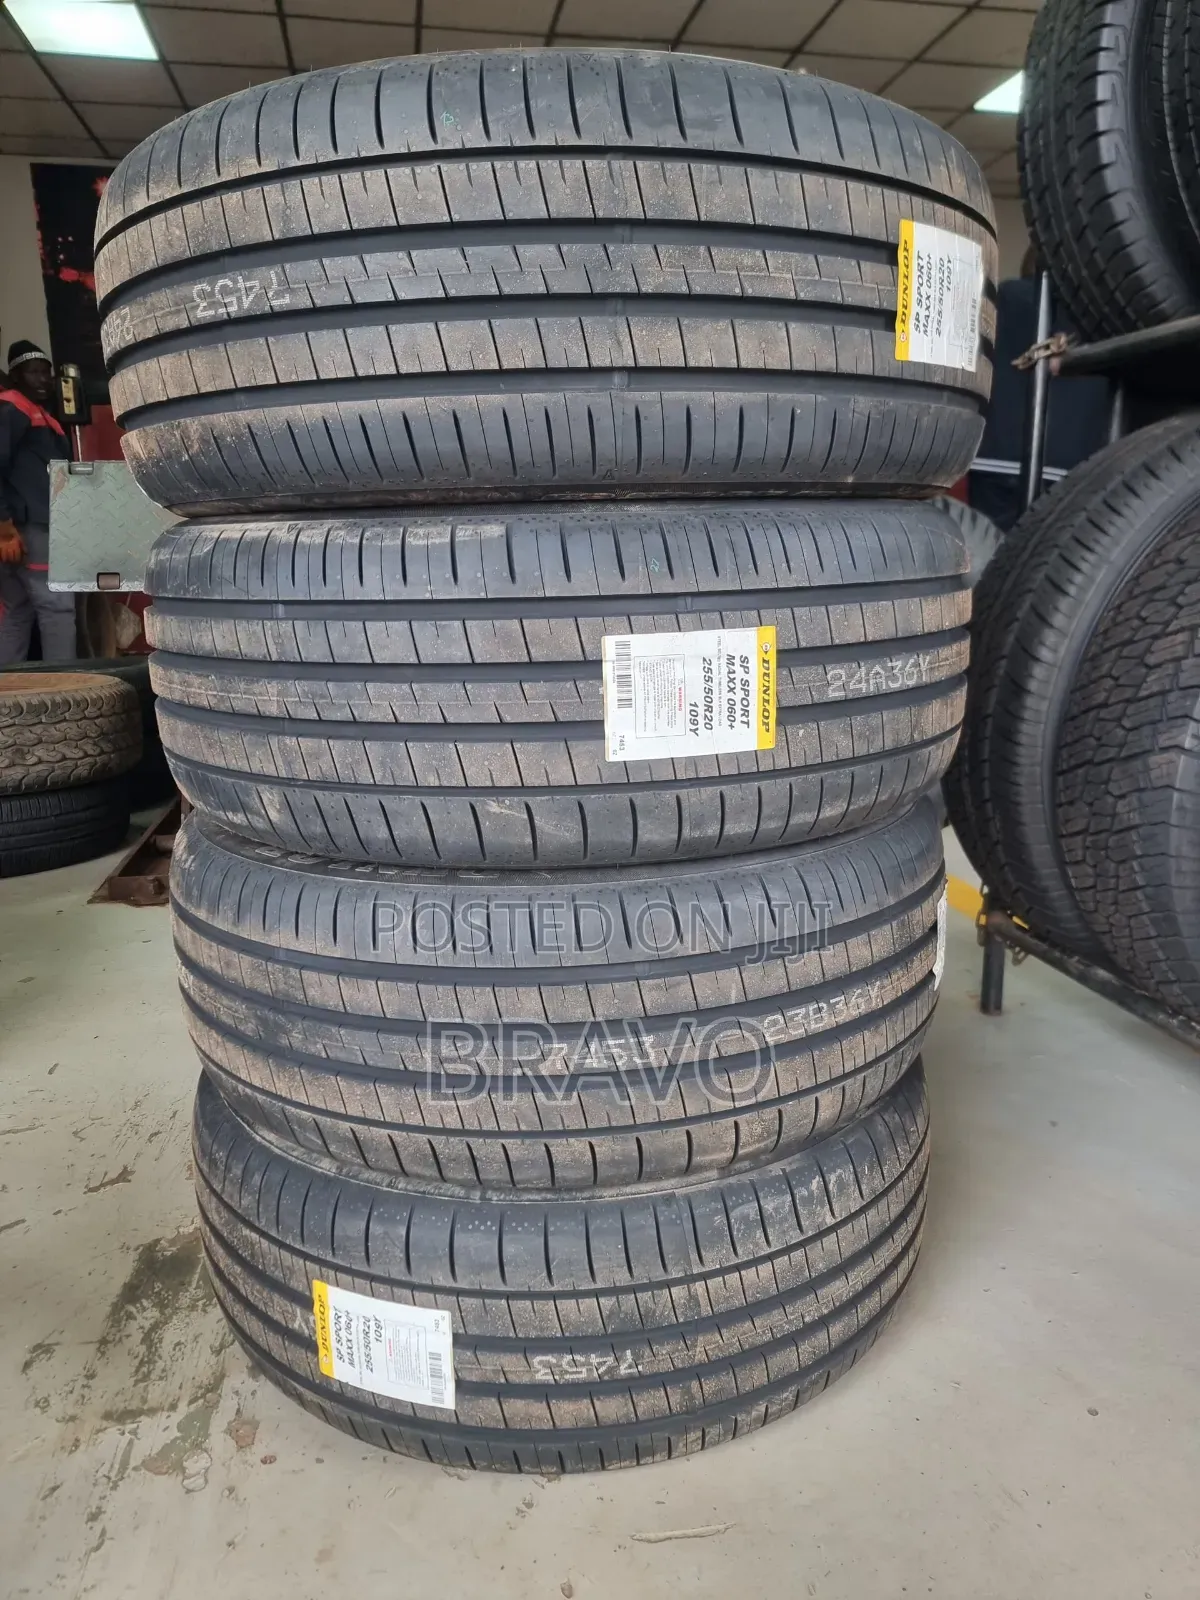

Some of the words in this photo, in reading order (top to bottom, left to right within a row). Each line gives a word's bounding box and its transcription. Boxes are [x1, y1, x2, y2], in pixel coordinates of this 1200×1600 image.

[899, 239, 910, 327] DUNLOP
[916, 250, 925, 308] SPORT
[926, 252, 934, 289] 060+
[945, 254, 953, 292] 109Y
[192, 270, 290, 318] 7453
[922, 291, 933, 338] MAXX
[935, 257, 946, 338] 255/50R20
[913, 313, 922, 334] SP
[726, 653, 737, 695] MAXX
[739, 654, 750, 675] SP
[826, 653, 930, 698] 24A36Y
[702, 656, 714, 731] 255/50R20
[726, 697, 737, 730] 060+
[739, 677, 750, 729] SPORT
[762, 657, 771, 733] DUNLOP
[689, 701, 699, 737] 109Y
[318, 1294, 329, 1353] DUNLOP
[333, 1305, 343, 1348] SPORT
[362, 1315, 374, 1374] 255/50R20
[372, 1314, 383, 1343] 109Y
[335, 1348, 346, 1363] SP
[344, 1336, 356, 1369] MAXX
[533, 1349, 642, 1380] 7453
